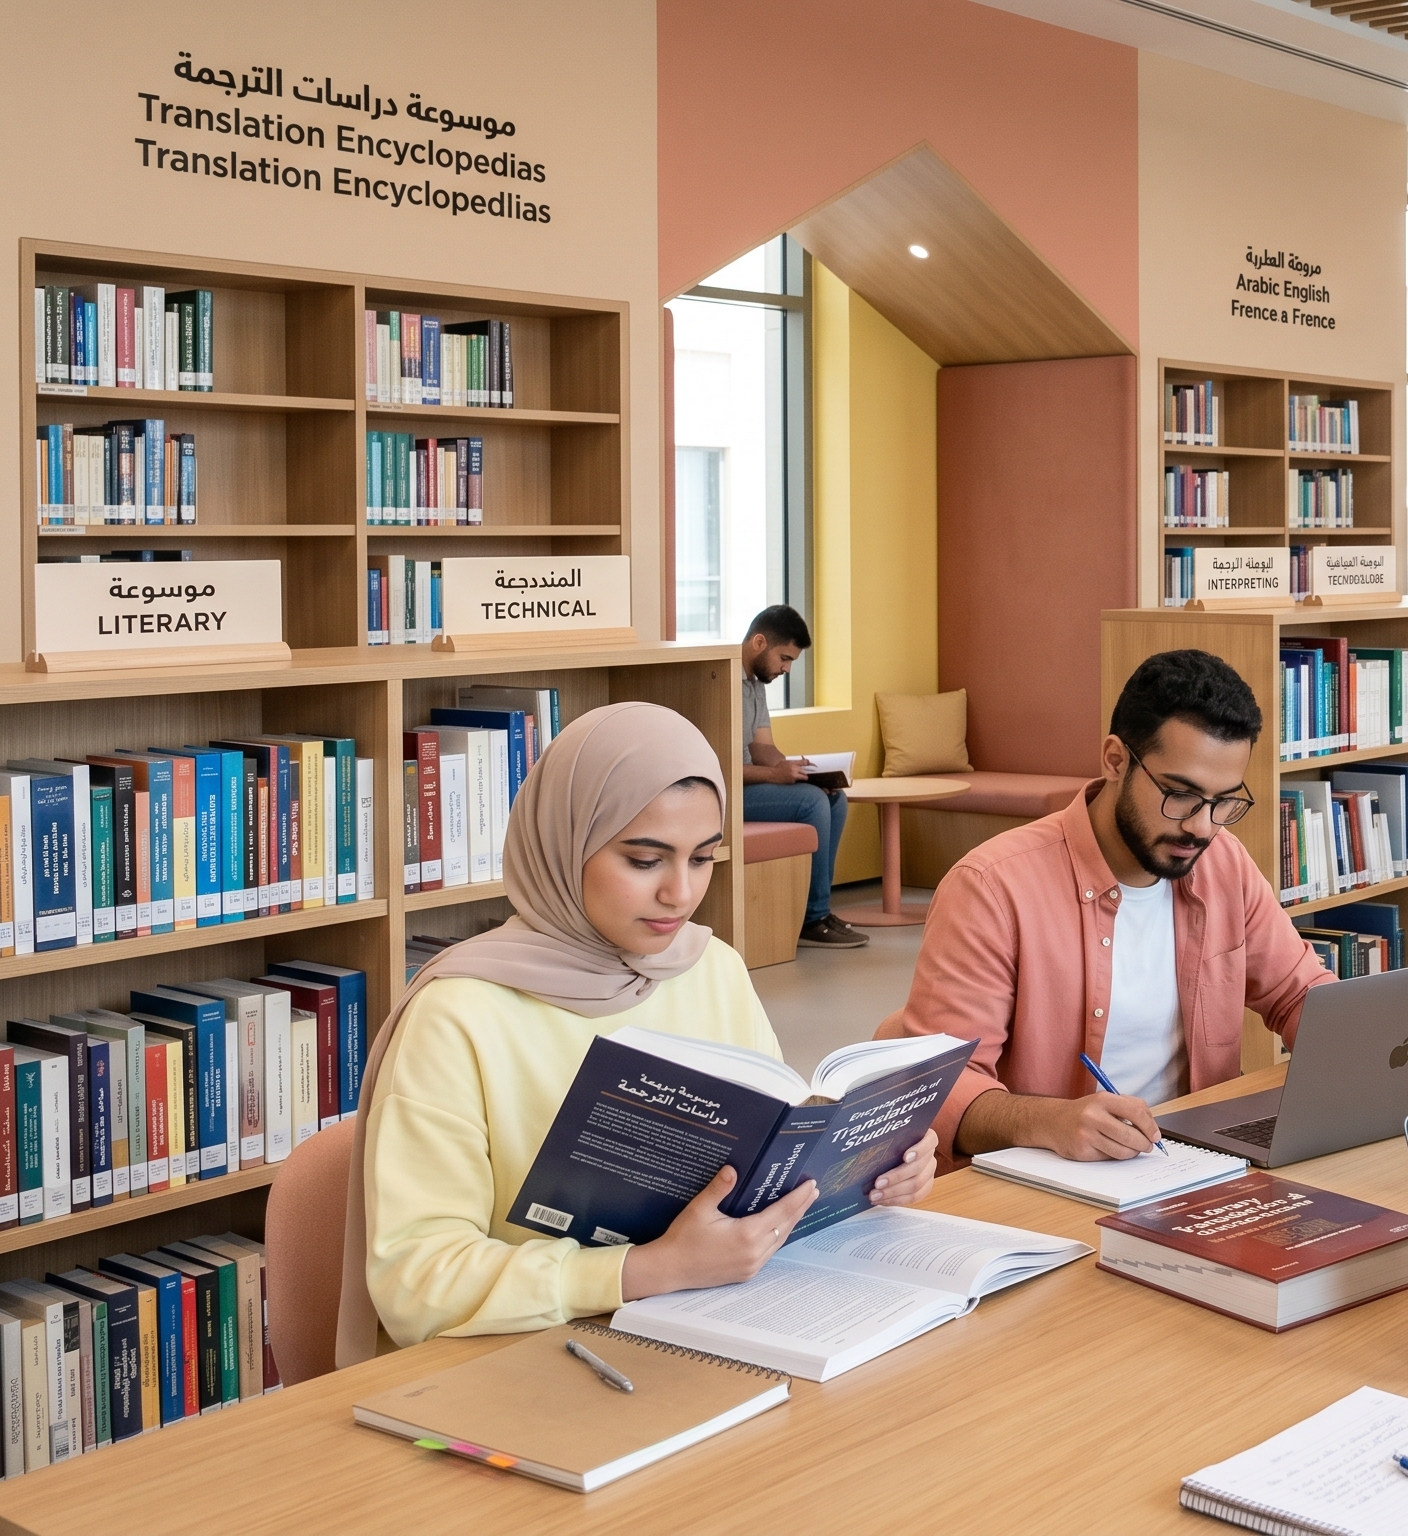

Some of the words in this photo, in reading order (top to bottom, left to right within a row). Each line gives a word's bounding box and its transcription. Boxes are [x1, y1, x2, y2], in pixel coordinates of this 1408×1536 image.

[174, 51, 282, 98] الترجمة
[293, 77, 397, 120] دراسات
[407, 93, 515, 139] موسوعة
[138, 93, 324, 148] Translation
[338, 125, 545, 182] Encyclopedias
[135, 138, 320, 191] Translation
[334, 168, 550, 223] Encyclopedlias
[1236, 274, 1279, 295] Arabic
[1284, 281, 1329, 303] English
[1232, 300, 1277, 321] Frence
[1293, 308, 1335, 329] Frence
[110, 578, 215, 604] موسوعة
[1208, 577, 1279, 590] INTERPRETING
[99, 612, 226, 634] LITERARY
[481, 600, 596, 619] TECHNICAL
